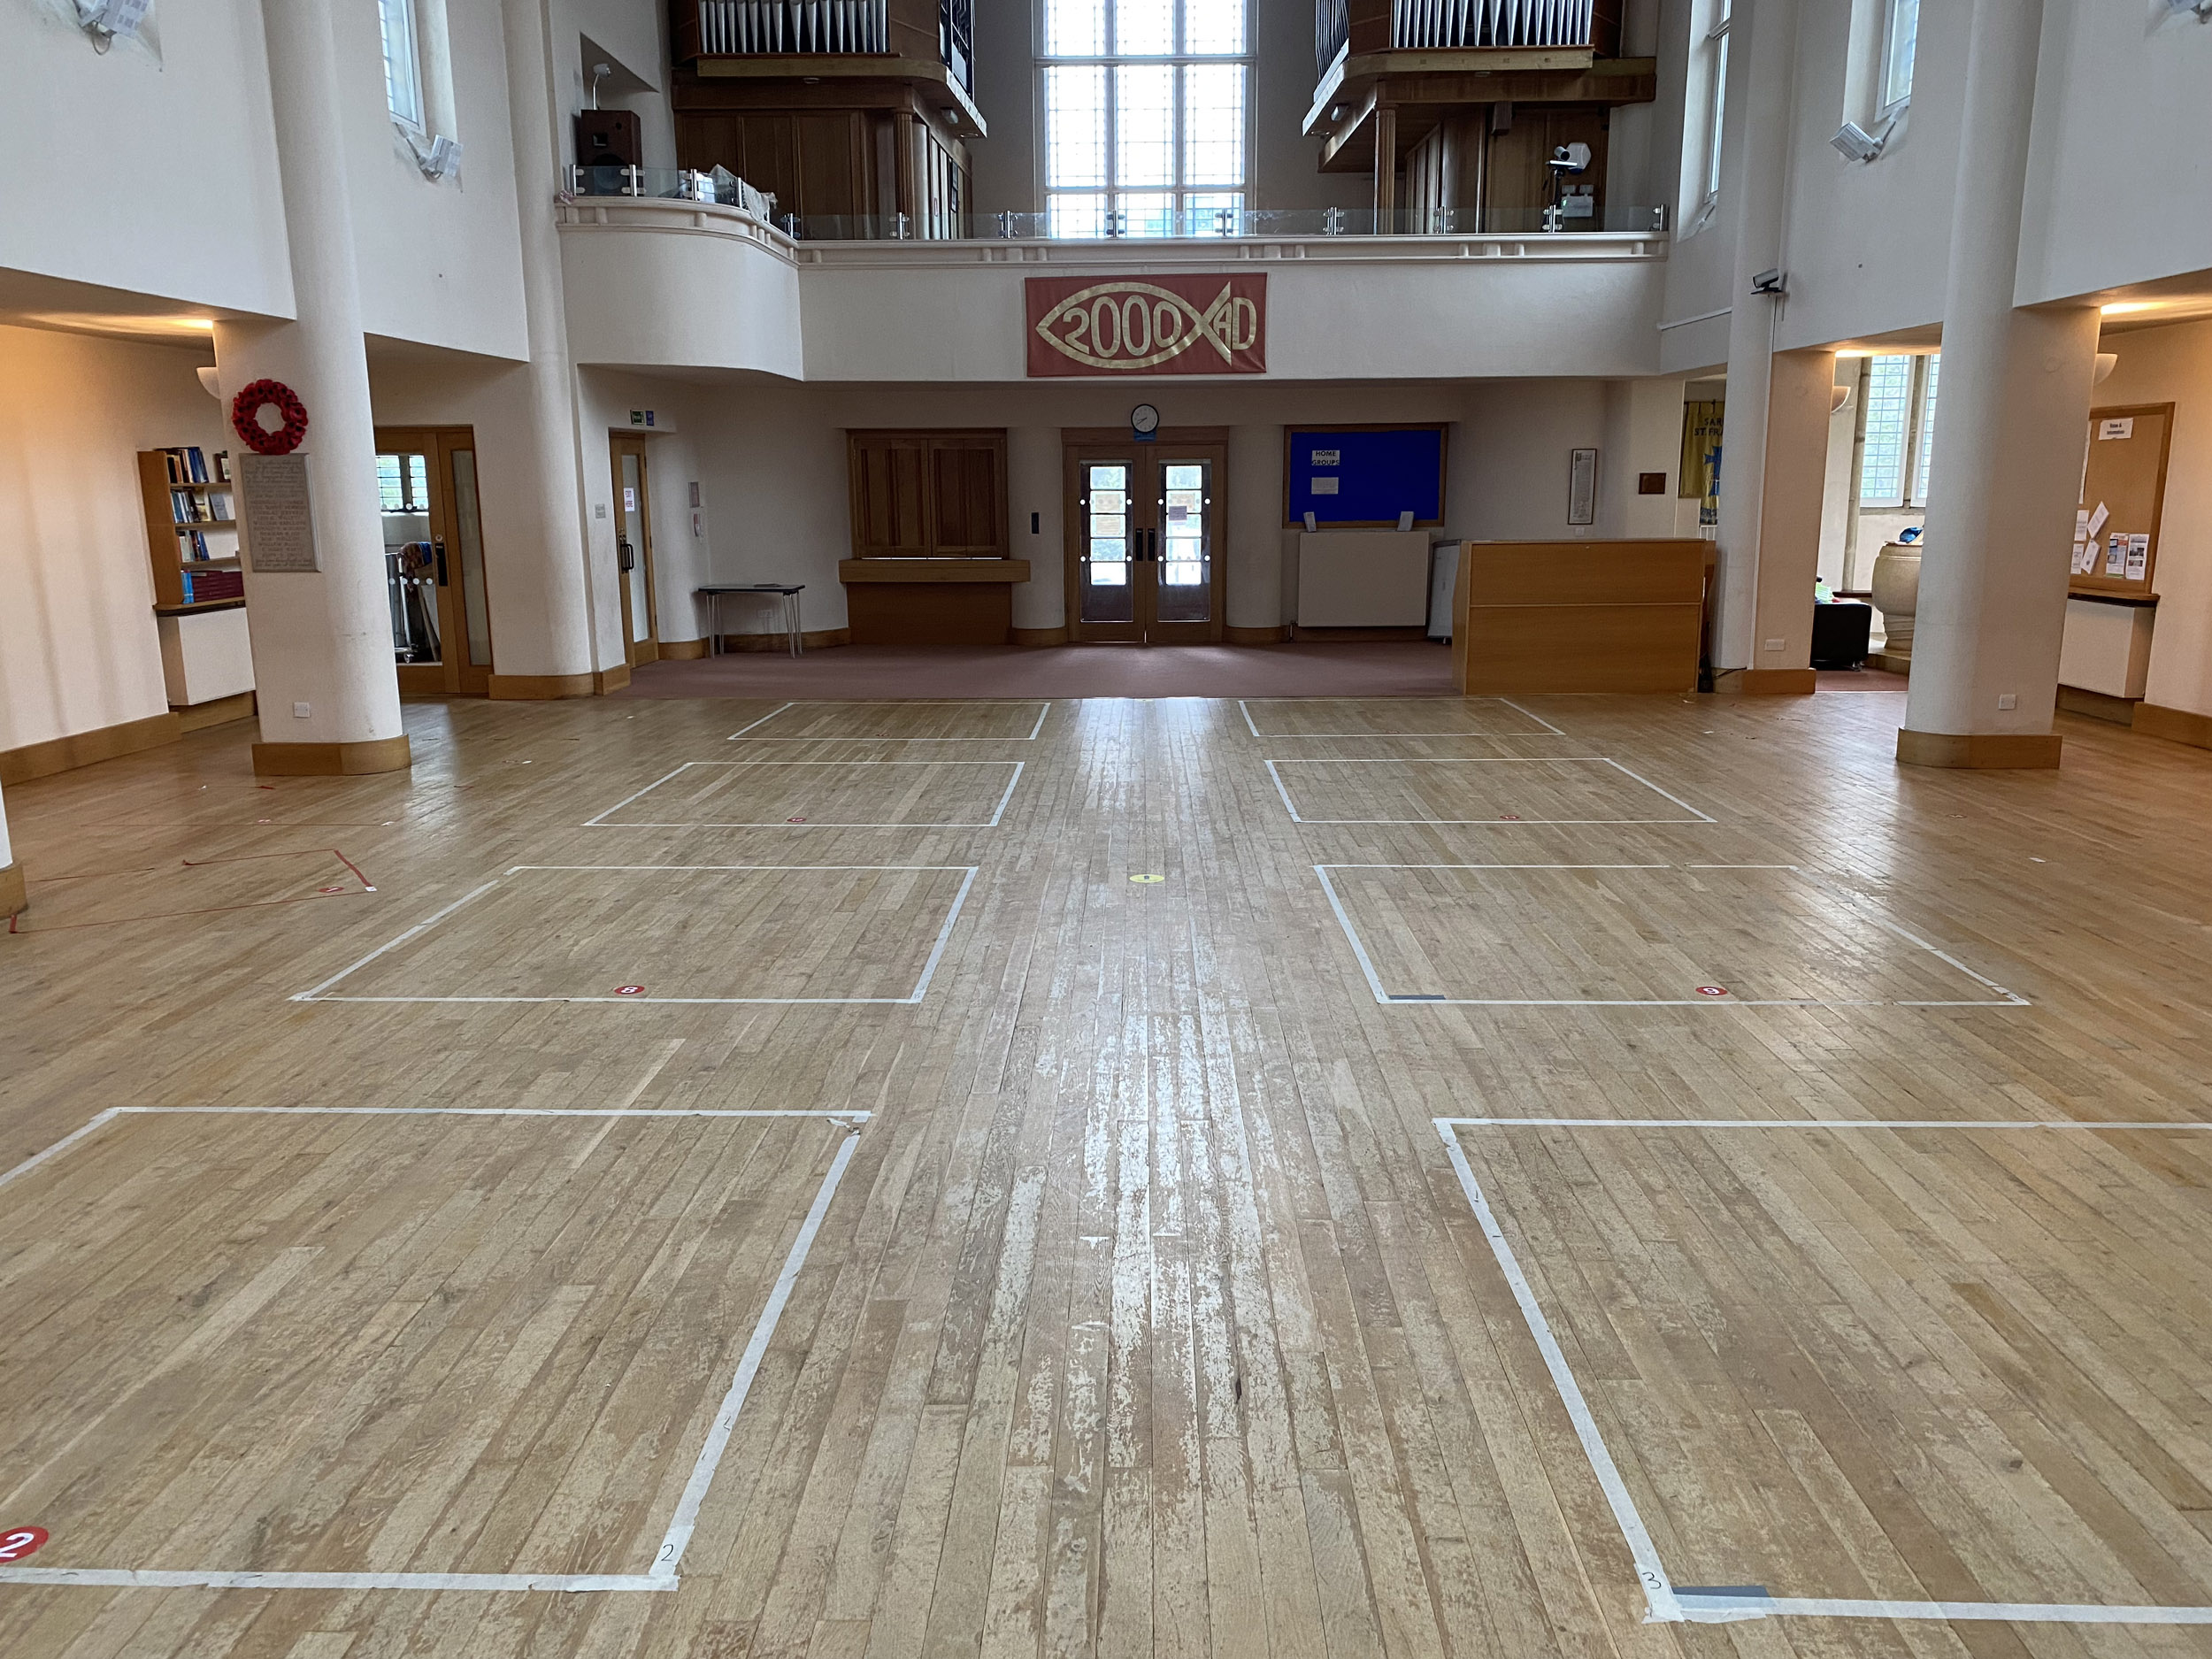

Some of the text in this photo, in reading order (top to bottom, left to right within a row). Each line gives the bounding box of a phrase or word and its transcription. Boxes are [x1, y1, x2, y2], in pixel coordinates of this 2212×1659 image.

[1062, 295, 1257, 357] 2000 AD
[0, 1532, 35, 1557] 2
[661, 1544, 673, 1561] 2
[1642, 1571, 1662, 1589] 3
